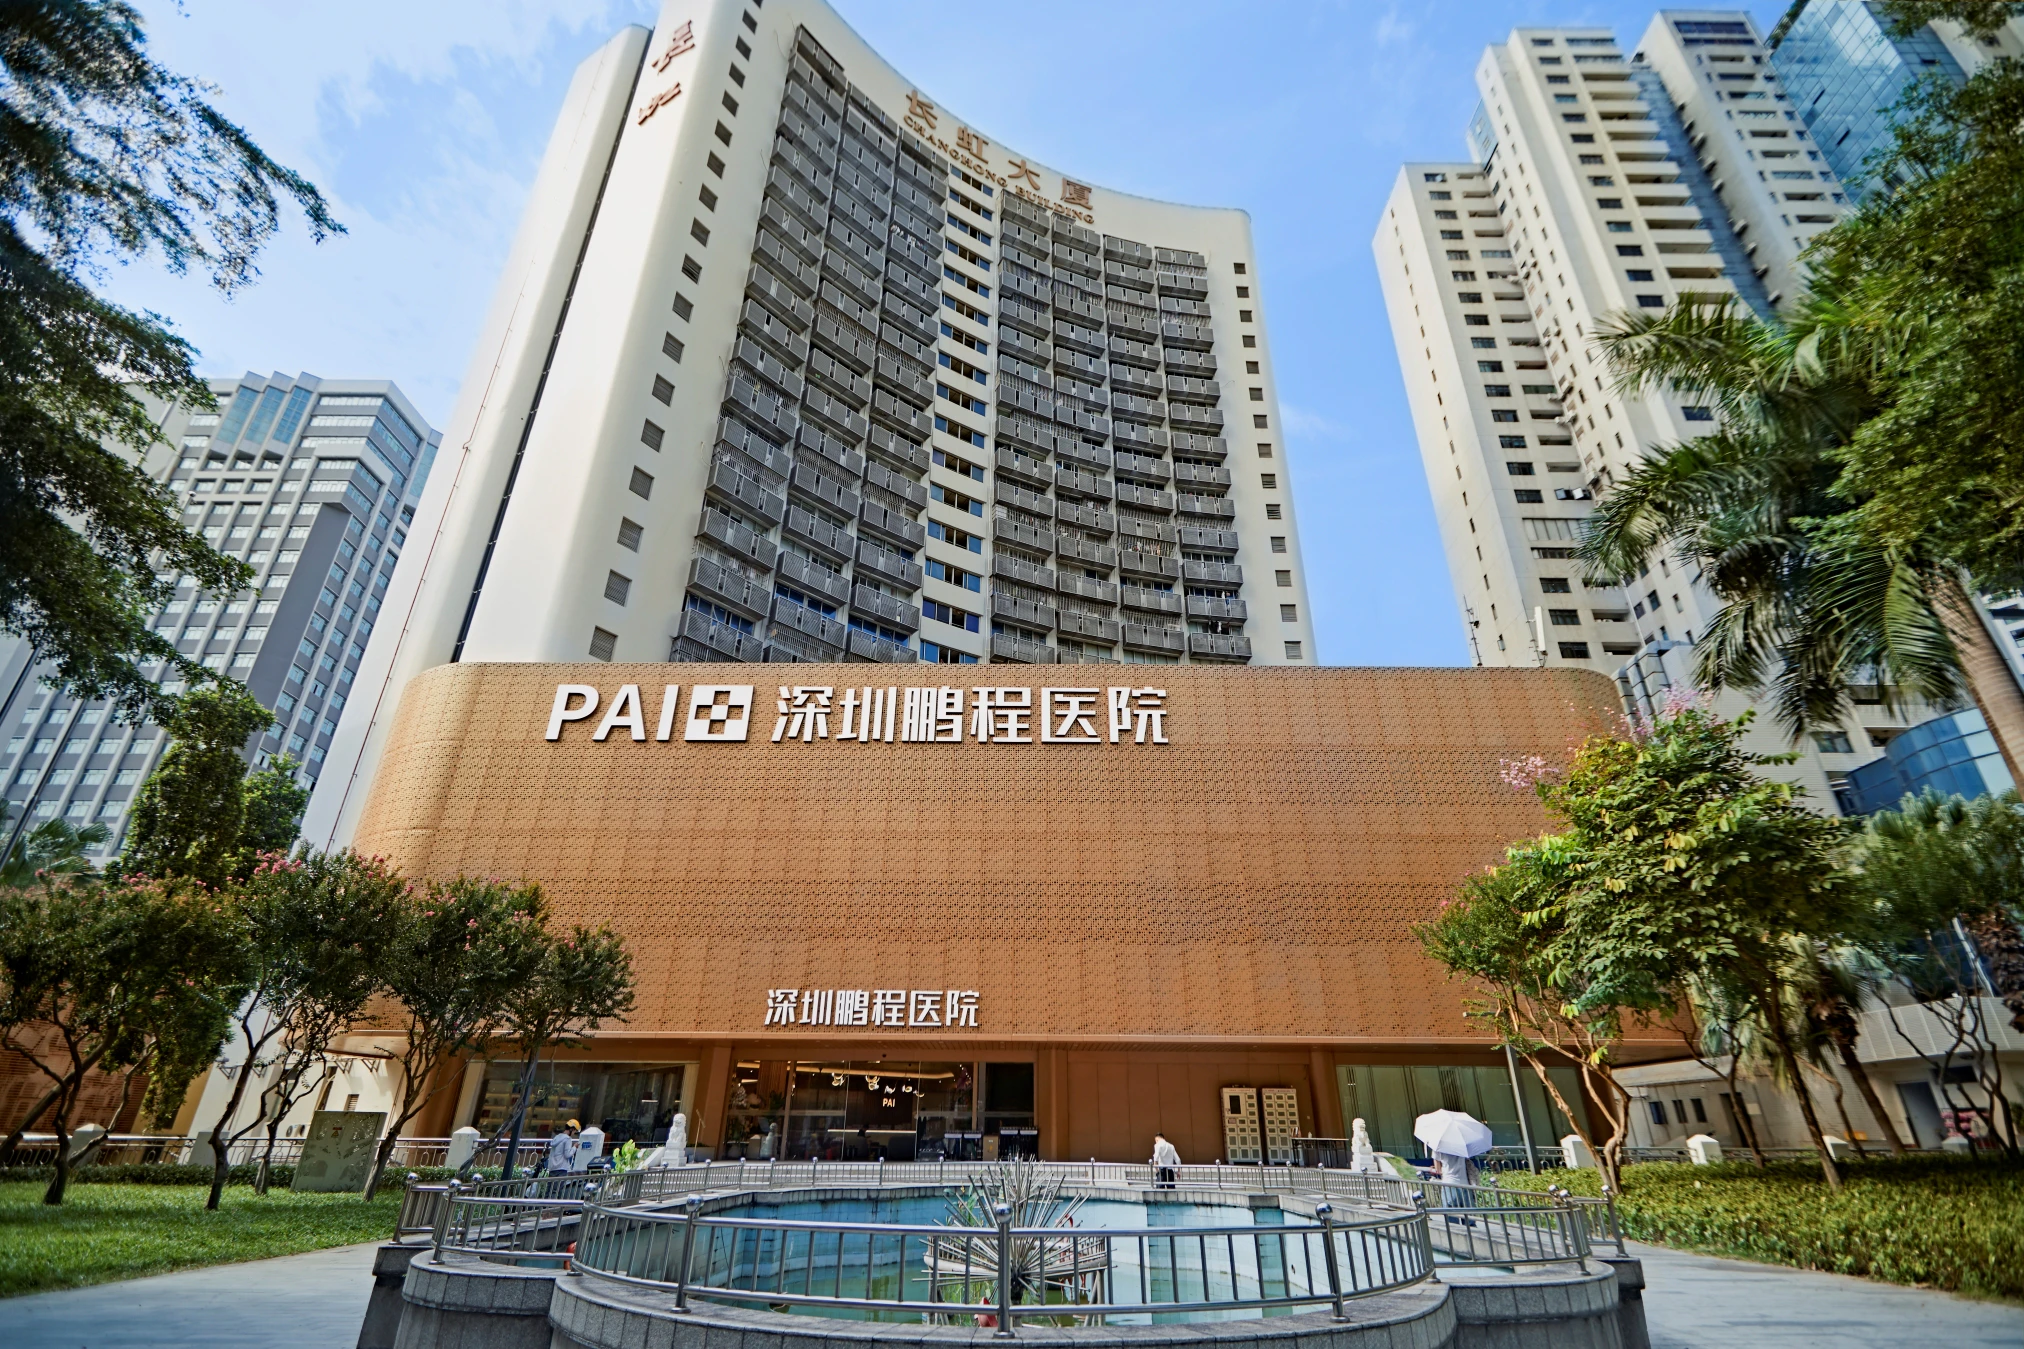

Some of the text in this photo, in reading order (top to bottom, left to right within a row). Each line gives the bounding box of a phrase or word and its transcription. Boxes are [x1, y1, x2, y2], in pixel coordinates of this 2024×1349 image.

[903, 114, 1095, 225] CHANGHONG BUILDING
[906, 89, 1093, 210] 长虹大厦
[545, 684, 1169, 745] PAI 深圳鹏程医院
[764, 988, 980, 1027] 深圳鹏程医院
[882, 1097, 896, 1108] PAI
